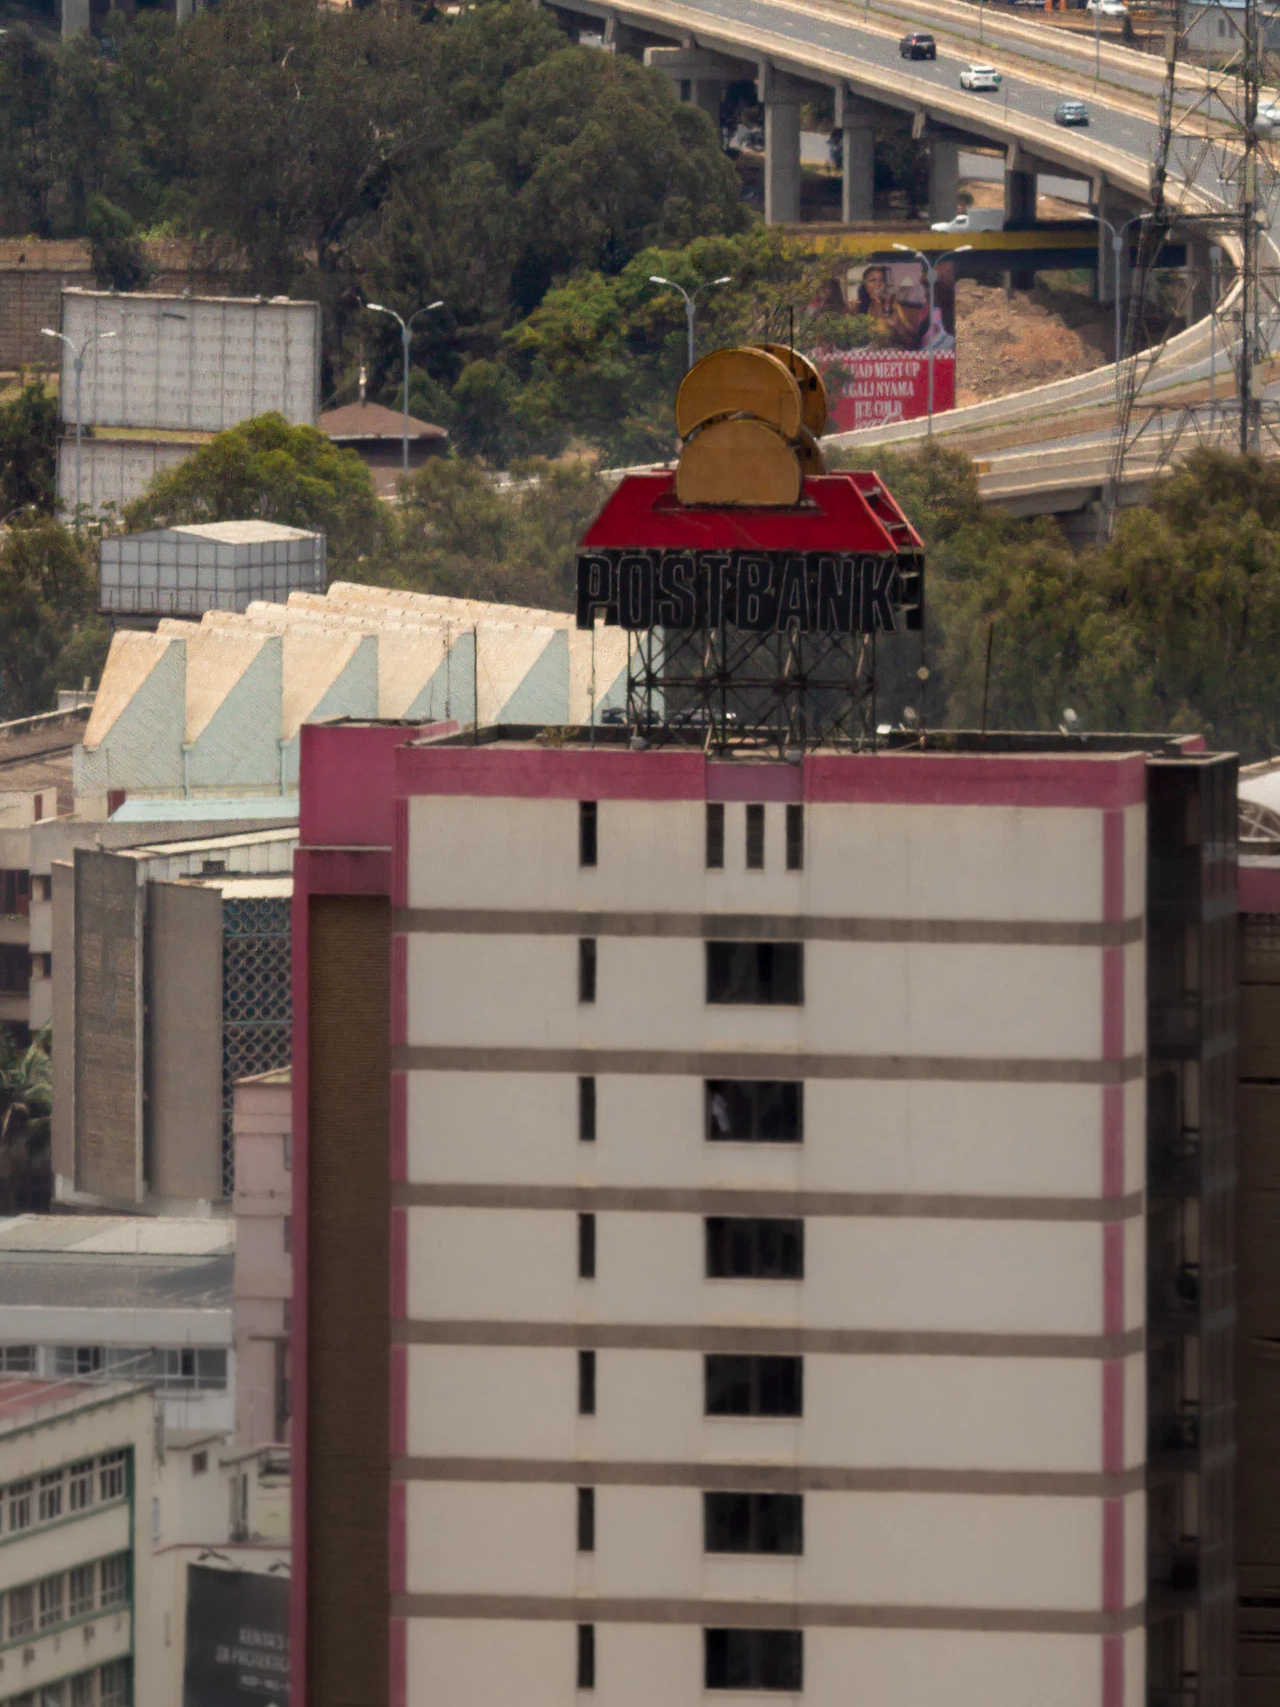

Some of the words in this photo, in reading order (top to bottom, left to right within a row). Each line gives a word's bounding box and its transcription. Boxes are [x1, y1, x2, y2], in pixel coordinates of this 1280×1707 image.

[874, 361, 906, 379] MEET
[906, 361, 920, 377] UP
[576, 553, 898, 634] POSTBANK
